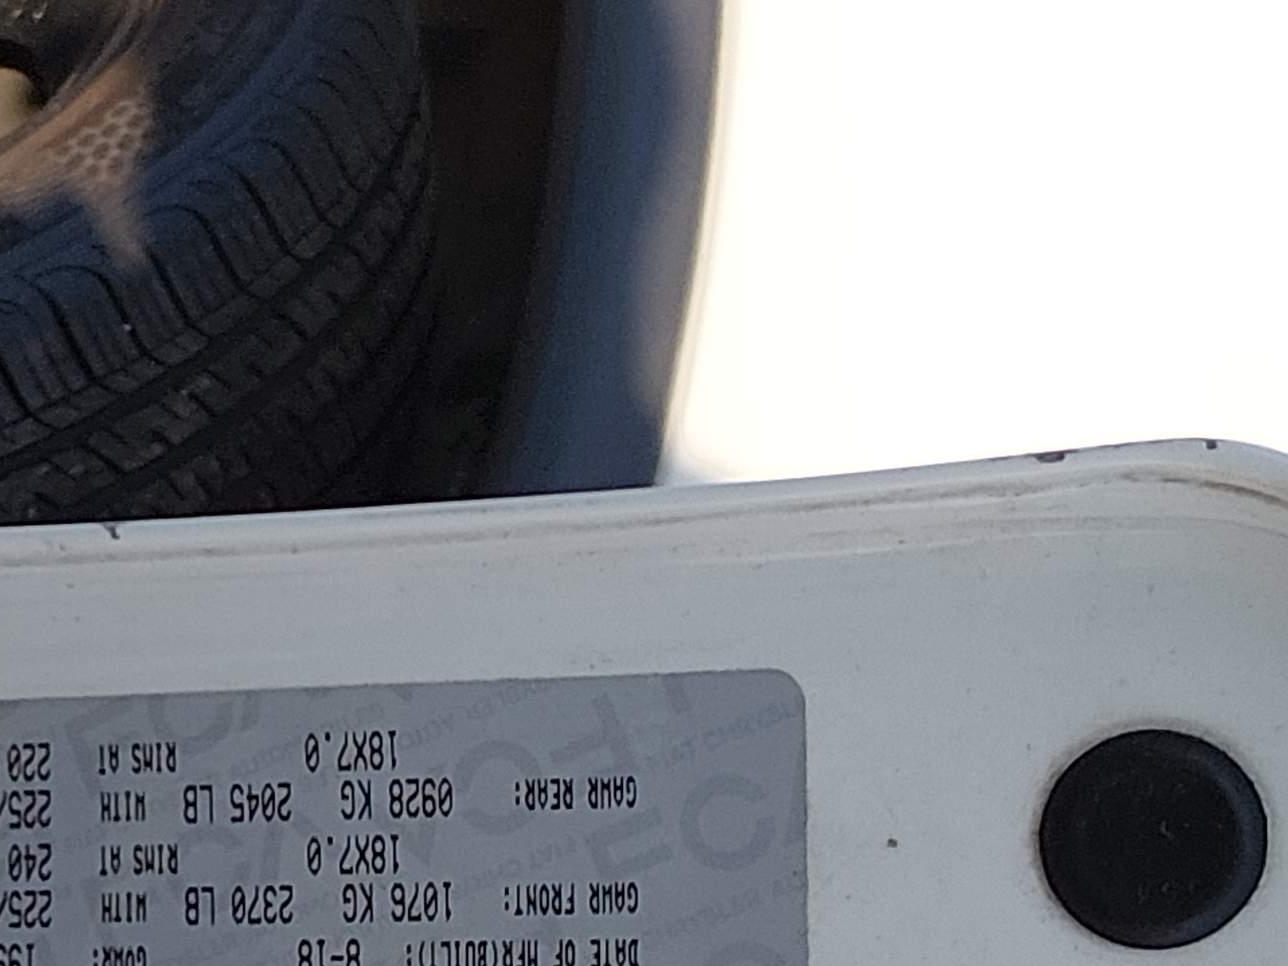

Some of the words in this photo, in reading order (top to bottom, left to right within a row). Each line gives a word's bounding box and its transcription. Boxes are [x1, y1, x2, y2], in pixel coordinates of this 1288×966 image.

[7, 742, 50, 782] 220
[99, 744, 119, 775] AT
[132, 742, 176, 774] RIMS
[305, 730, 396, 772] 18X7.0
[100, 791, 146, 822] WITH
[183, 784, 213, 824] LB
[230, 782, 291, 823] 2045
[341, 779, 372, 820] KG
[389, 777, 452, 818] 0928
[515, 778, 573, 811] REAR:
[588, 776, 636, 809] GAWR
[8, 843, 52, 882] 240
[100, 846, 121, 876] AT
[133, 844, 178, 875] RIMS
[307, 834, 399, 876] 18X7.0
[102, 892, 146, 923] WITH
[185, 886, 215, 926] LB
[232, 885, 293, 925] 2370
[342, 883, 373, 923] KG
[391, 882, 451, 922] 1076
[505, 883, 575, 916] FRONT:
[589, 882, 638, 914] GAWR
